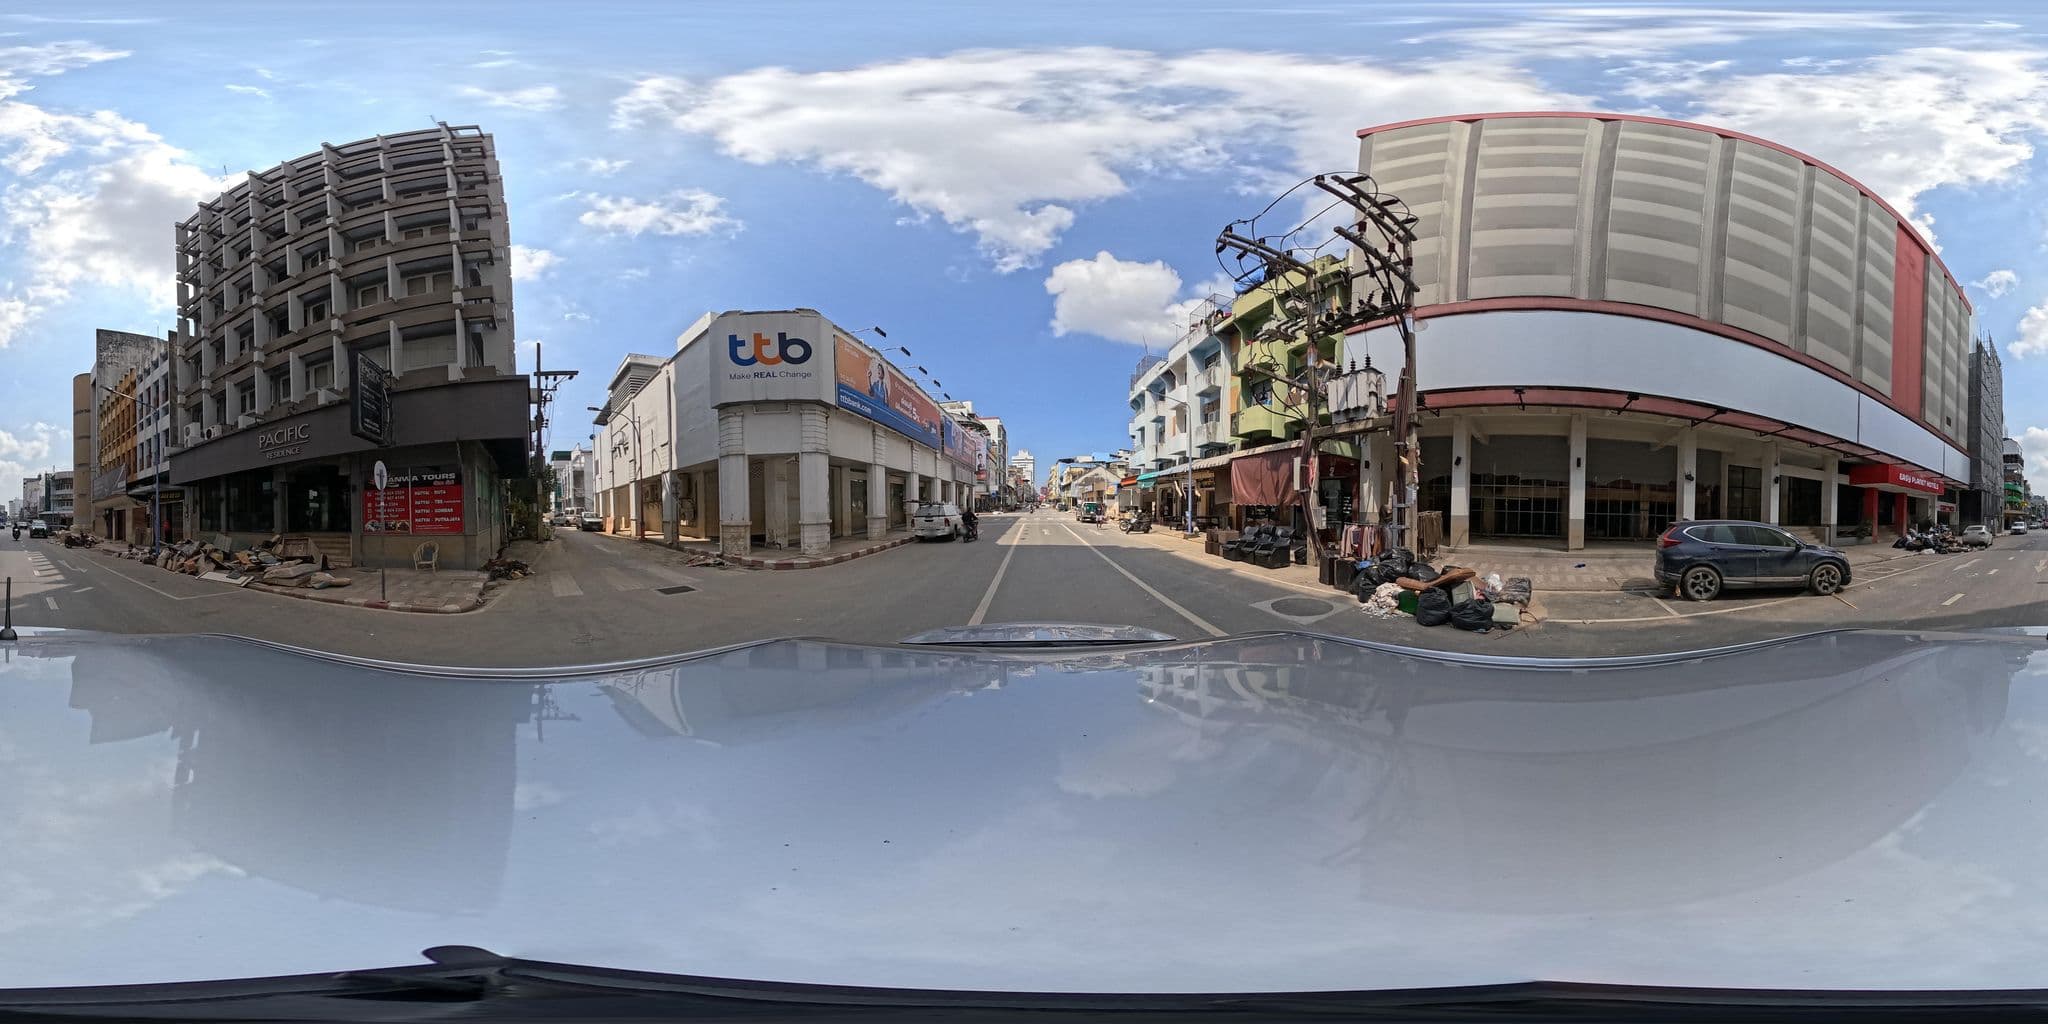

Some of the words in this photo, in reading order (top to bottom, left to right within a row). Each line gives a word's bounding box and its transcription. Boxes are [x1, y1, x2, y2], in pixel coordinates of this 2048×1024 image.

[728, 332, 812, 366] ttb
[753, 371, 778, 379] REAL
[779, 370, 812, 379] Change
[840, 395, 872, 415] ttbbank.com
[259, 423, 309, 448] PACIFIC
[266, 447, 300, 460] RESIDENCE
[421, 472, 456, 480] TOURS
[1927, 481, 1938, 490] HOTELS
